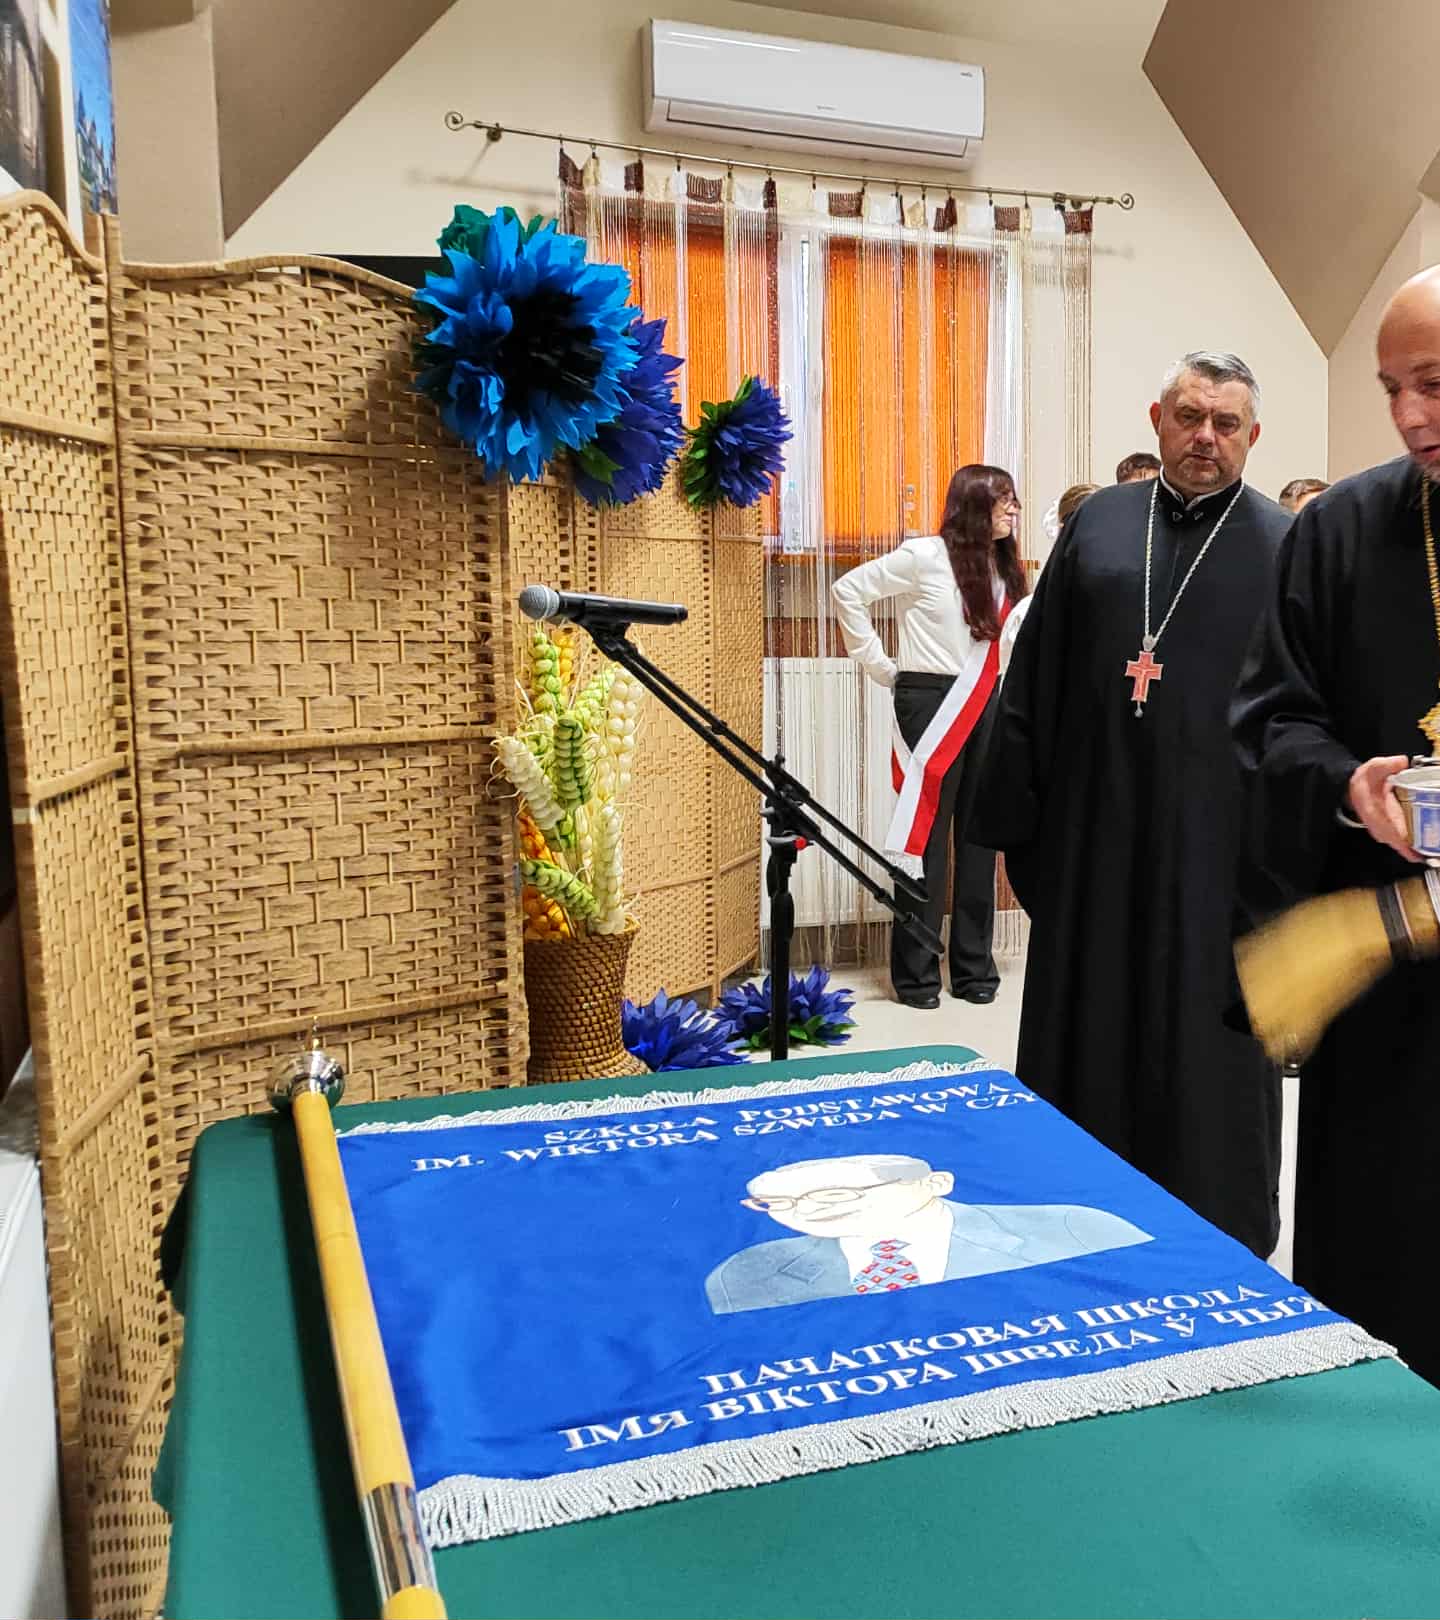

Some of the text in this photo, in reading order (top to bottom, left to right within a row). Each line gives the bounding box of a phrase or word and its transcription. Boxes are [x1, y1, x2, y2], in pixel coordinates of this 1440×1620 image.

[411, 1154, 486, 1172] IM.
[502, 1129, 719, 1161] WIKTORA
[733, 1109, 901, 1137] SZWEDA
[912, 1103, 950, 1115] W
[739, 1081, 1012, 1122] PODSTAWOWA
[557, 1409, 695, 1453] ІМЯ
[700, 1355, 958, 1422] ВІКТОРА
[960, 1328, 1165, 1375] ШВЕДА
[1161, 1312, 1198, 1338] Ў
[699, 1284, 1271, 1396] ПАЧАТКОВАЯ ШКОЛА
